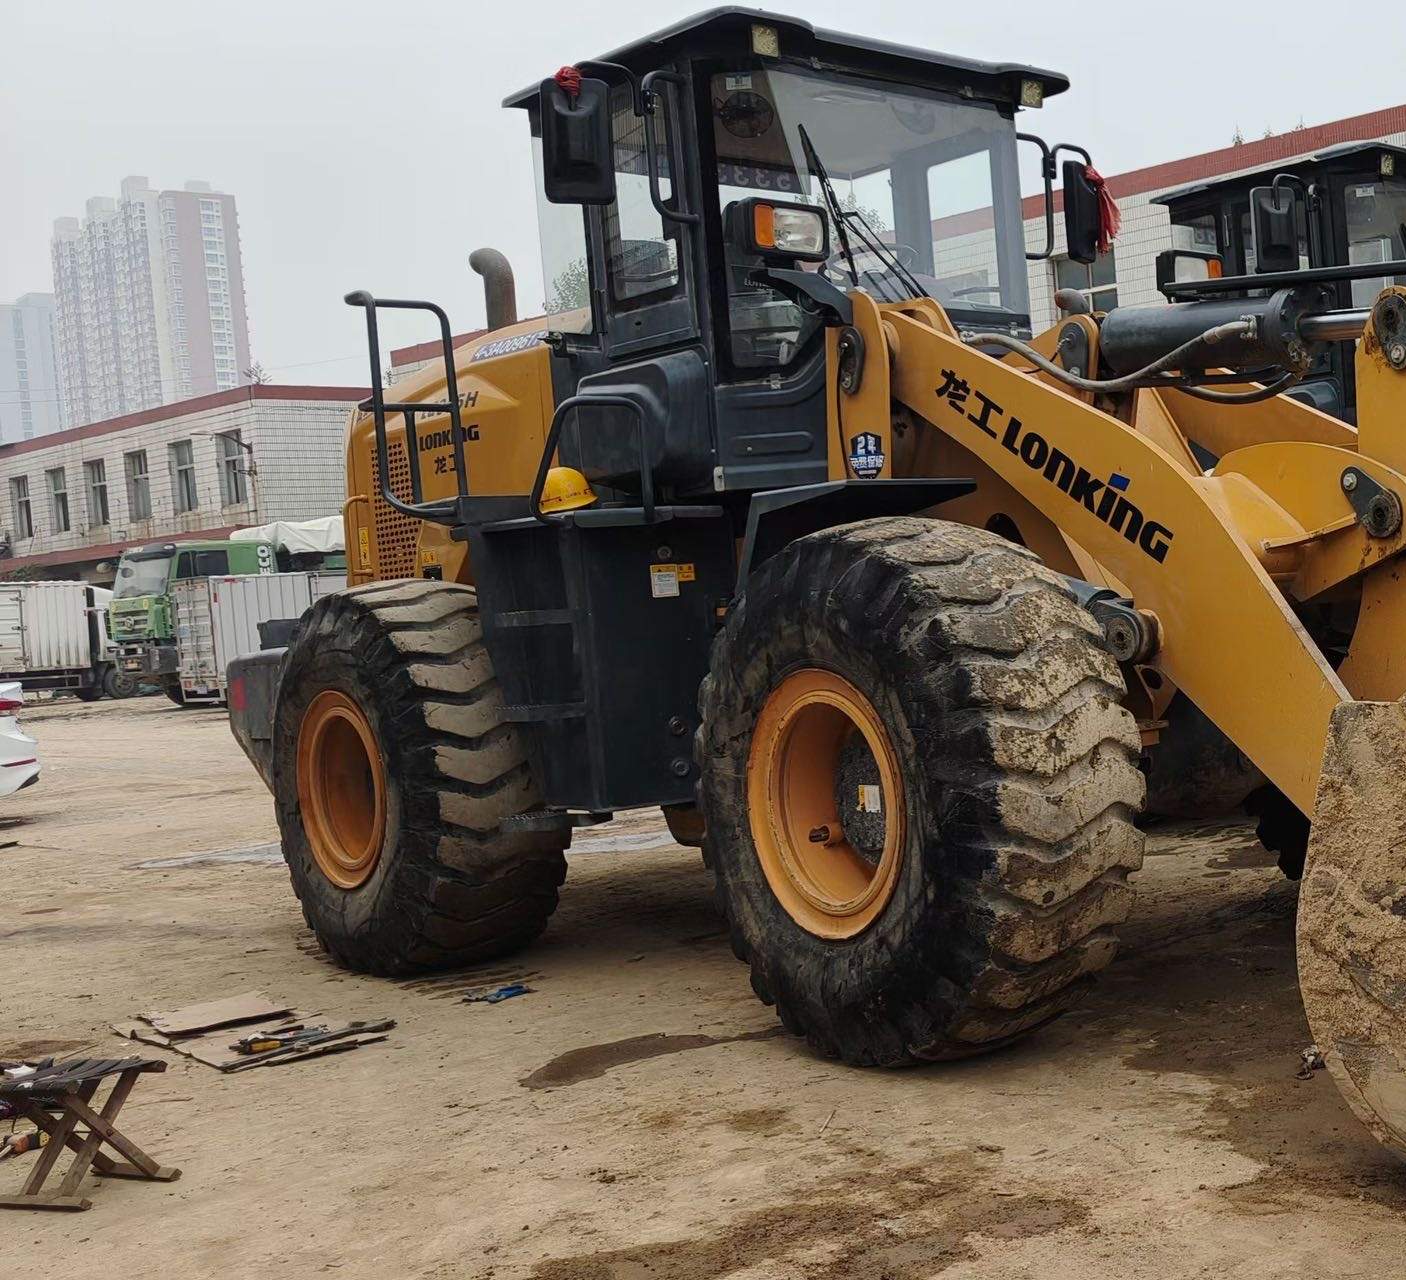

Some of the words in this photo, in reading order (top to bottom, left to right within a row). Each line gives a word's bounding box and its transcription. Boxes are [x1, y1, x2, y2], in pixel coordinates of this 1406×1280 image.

[420, 424, 480, 451] LONKNG
[935, 368, 1003, 439] 龙工
[1002, 416, 1174, 564] LONKING
